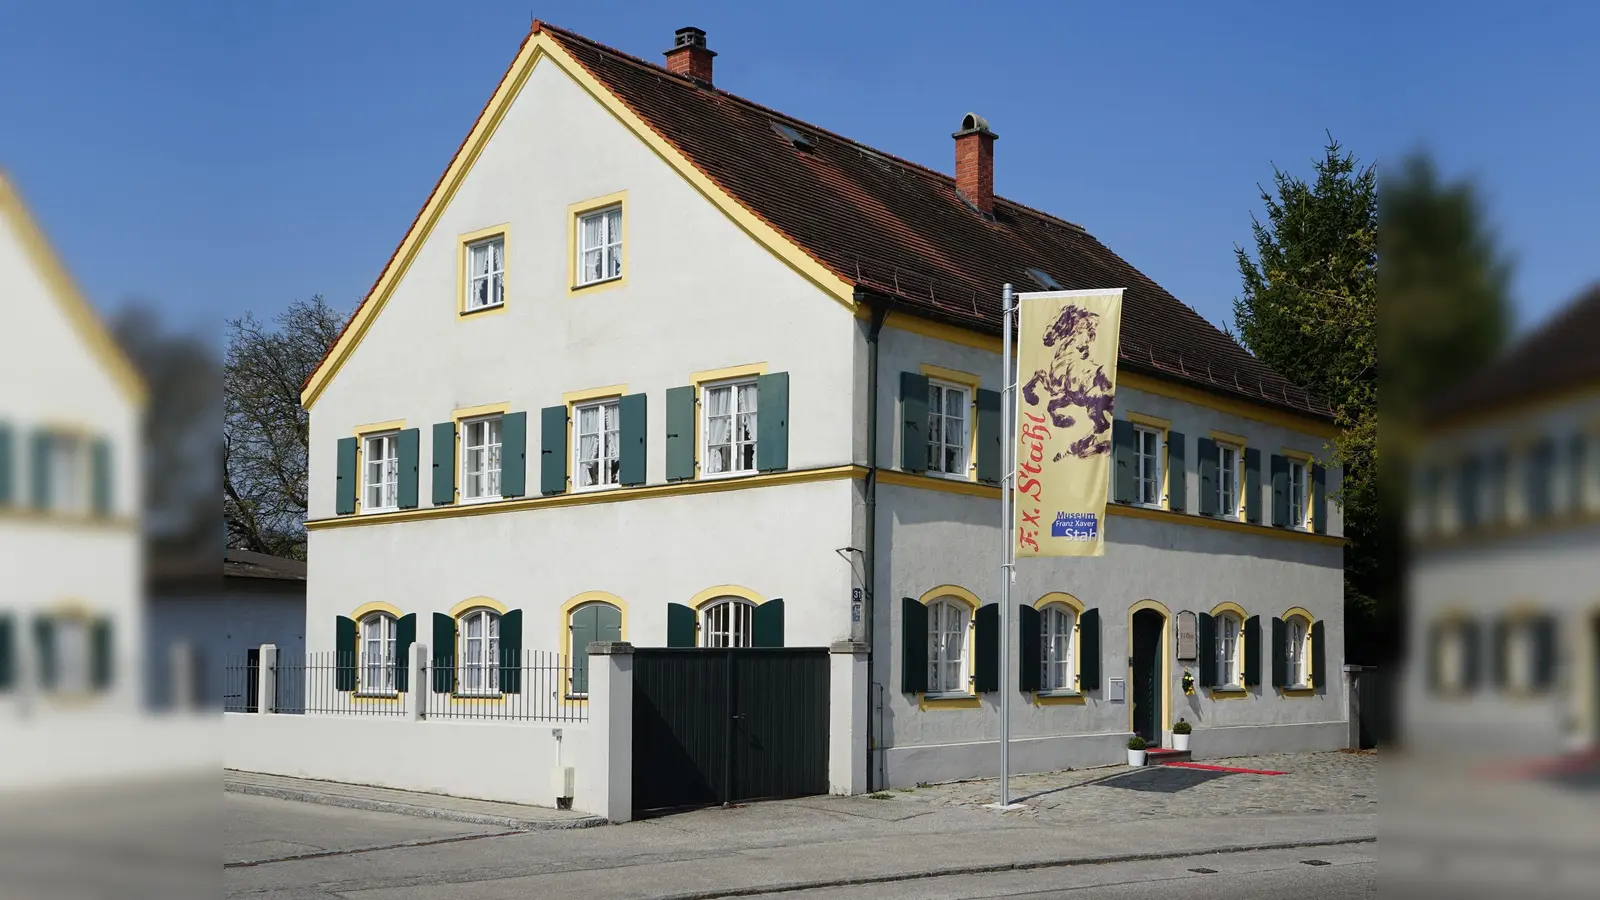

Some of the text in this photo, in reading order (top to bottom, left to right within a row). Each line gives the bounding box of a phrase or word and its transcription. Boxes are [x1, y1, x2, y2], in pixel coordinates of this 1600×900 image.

[1018, 411, 1052, 502] Stahl
[1056, 511, 1095, 519] Museum
[853, 590, 861, 599] 31
